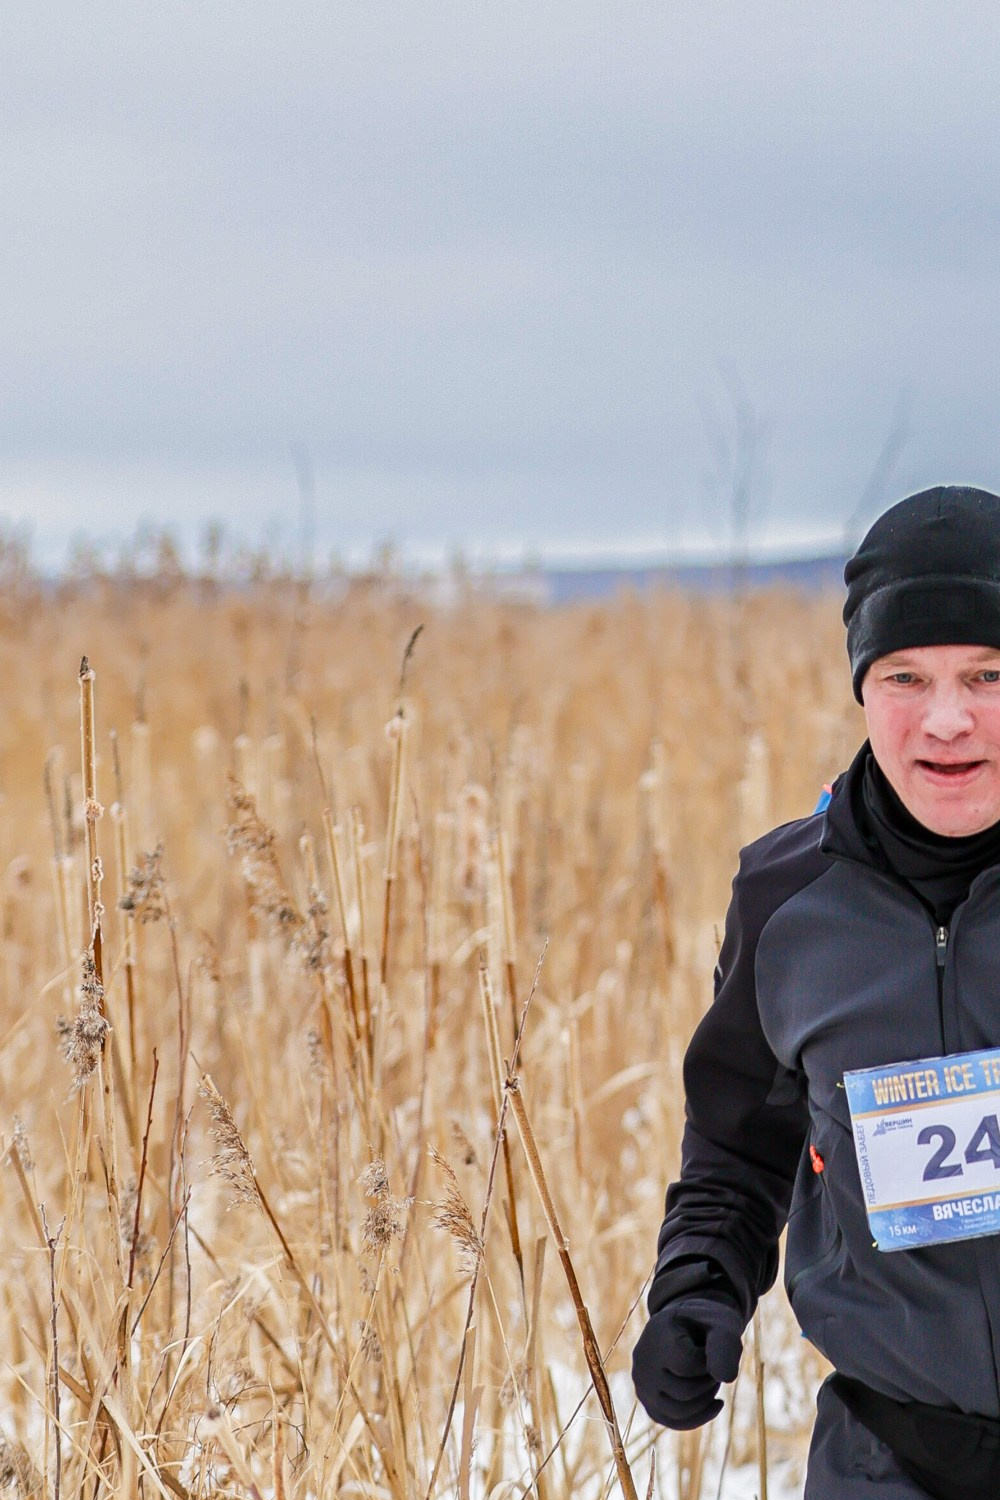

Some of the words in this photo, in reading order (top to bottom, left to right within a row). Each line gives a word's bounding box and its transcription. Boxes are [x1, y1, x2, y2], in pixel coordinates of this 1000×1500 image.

[872, 1069, 939, 1105] WINTER
[943, 1063, 976, 1094] ICE
[856, 1122, 867, 1153] ЗАБЕГ
[889, 1224, 901, 1237] 15
